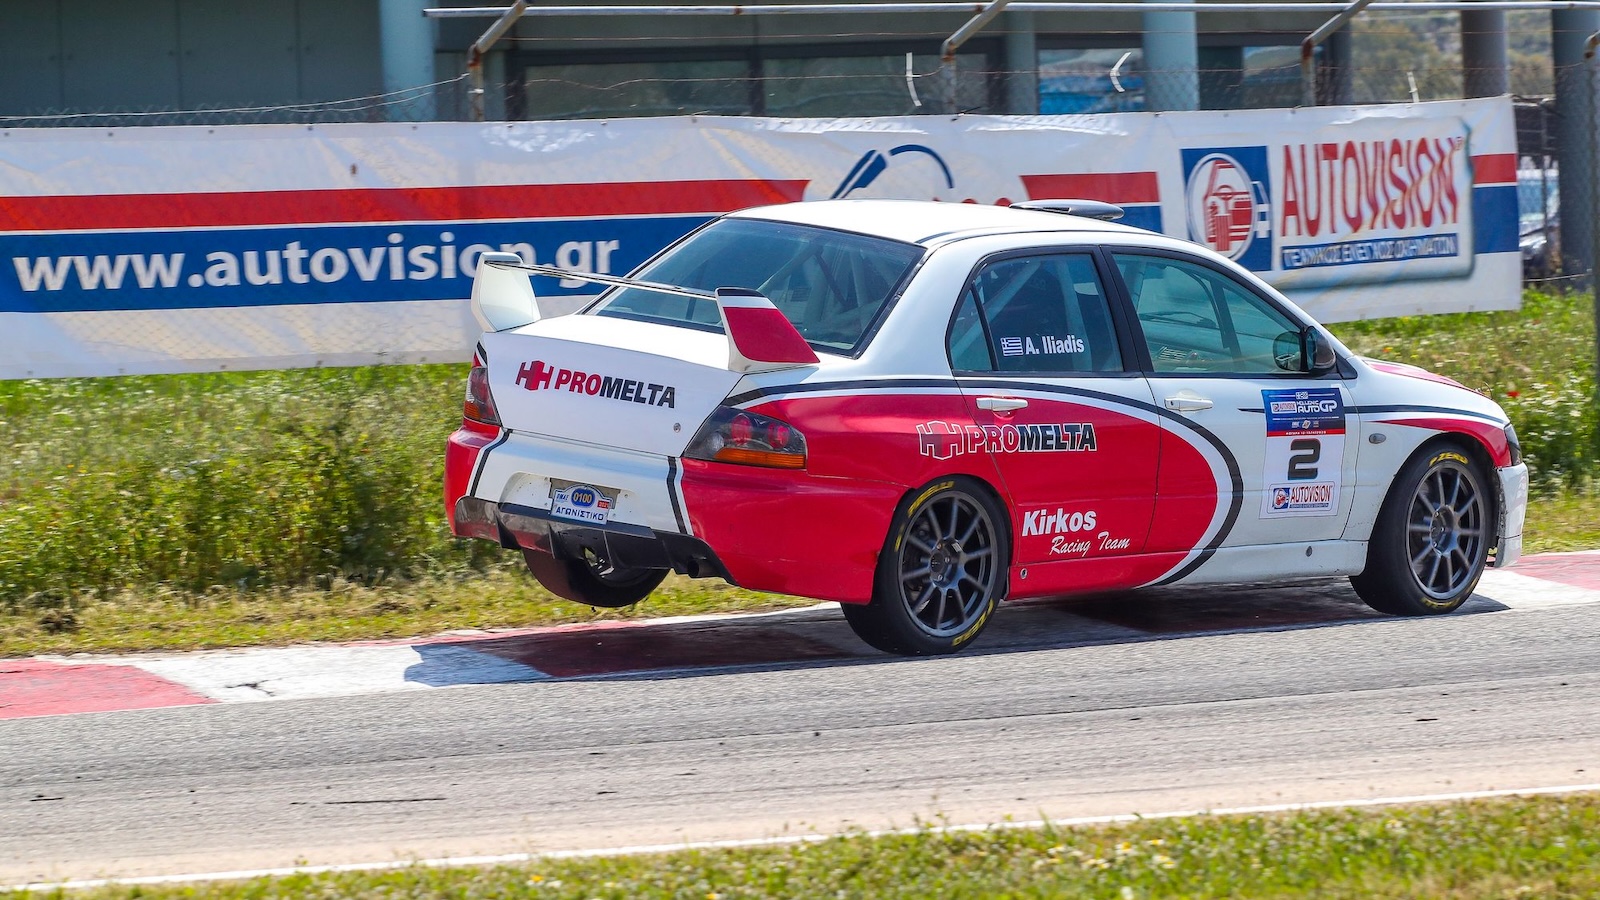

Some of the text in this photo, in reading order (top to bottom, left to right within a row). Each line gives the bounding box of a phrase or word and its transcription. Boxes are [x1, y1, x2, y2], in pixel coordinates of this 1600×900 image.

[1281, 137, 1458, 237] AUTOVISION
[12, 231, 619, 292] www.autovisiongr
[1025, 334, 1084, 354] A. Iliadis
[554, 368, 676, 409] PROMELTA
[965, 422, 1097, 453] PROMELTA
[1287, 438, 1321, 480] 2
[573, 492, 592, 503] 0100
[1290, 485, 1331, 503] AUTOVISION
[556, 506, 604, 521] ΑΓΩΝΙΣΤΙΚΟ
[1022, 508, 1097, 536] Kirkos
[1049, 531, 1130, 557] Racing Team
